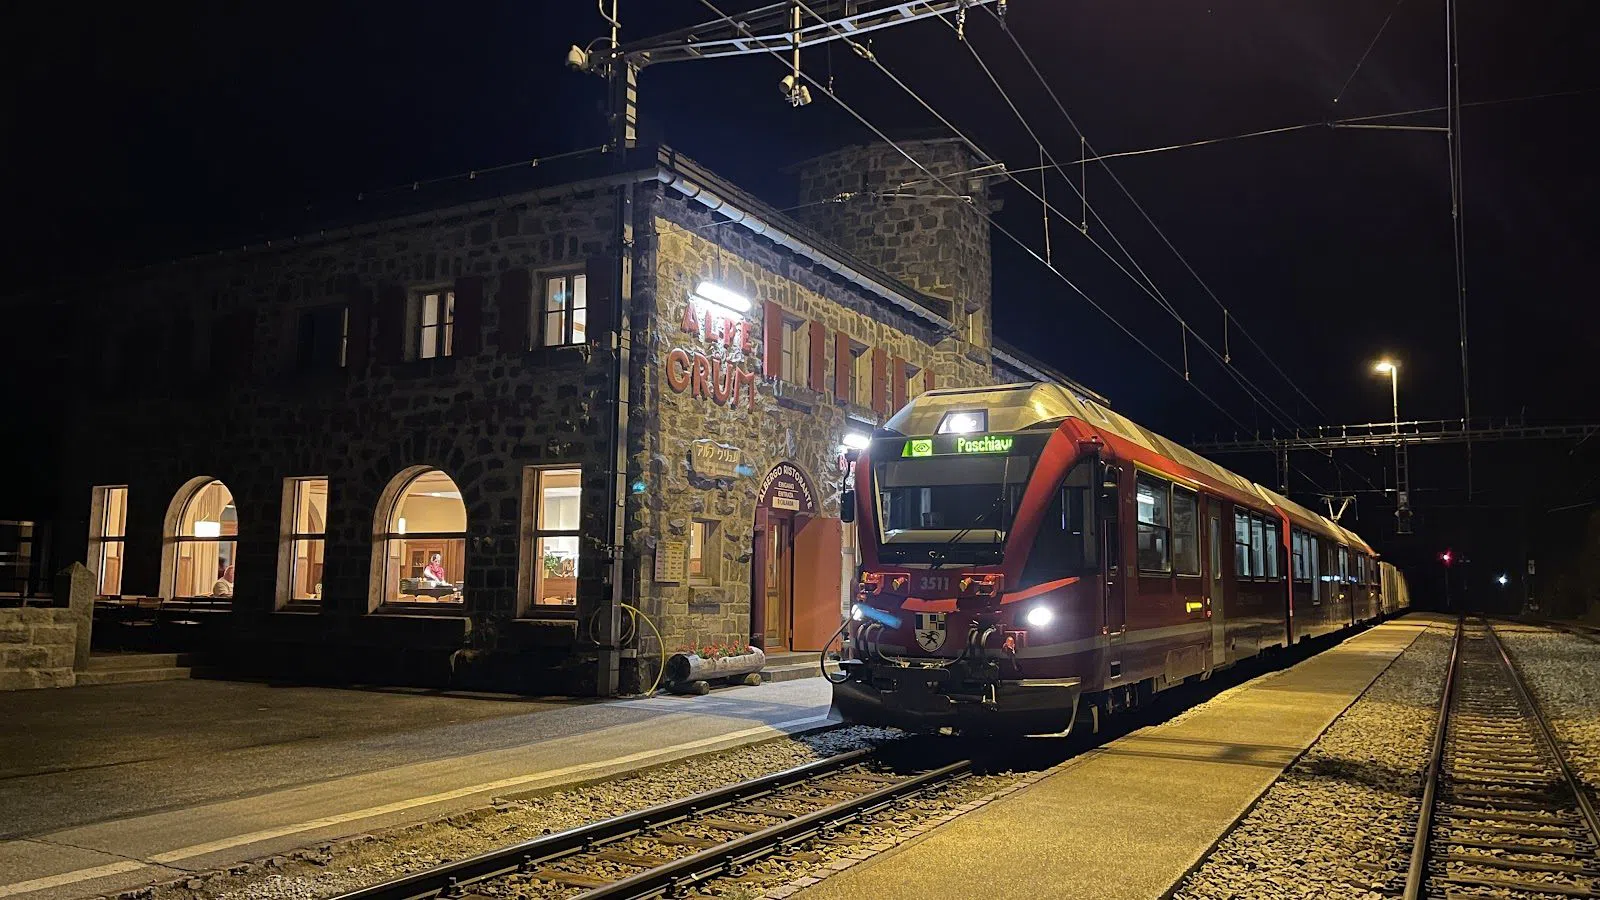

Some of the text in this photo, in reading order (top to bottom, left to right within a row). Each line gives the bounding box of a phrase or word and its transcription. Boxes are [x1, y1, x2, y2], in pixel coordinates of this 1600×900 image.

[681, 301, 751, 354] ALPE
[759, 465, 813, 510] ALBERGO RISTORANTE
[920, 576, 949, 591] 3511
